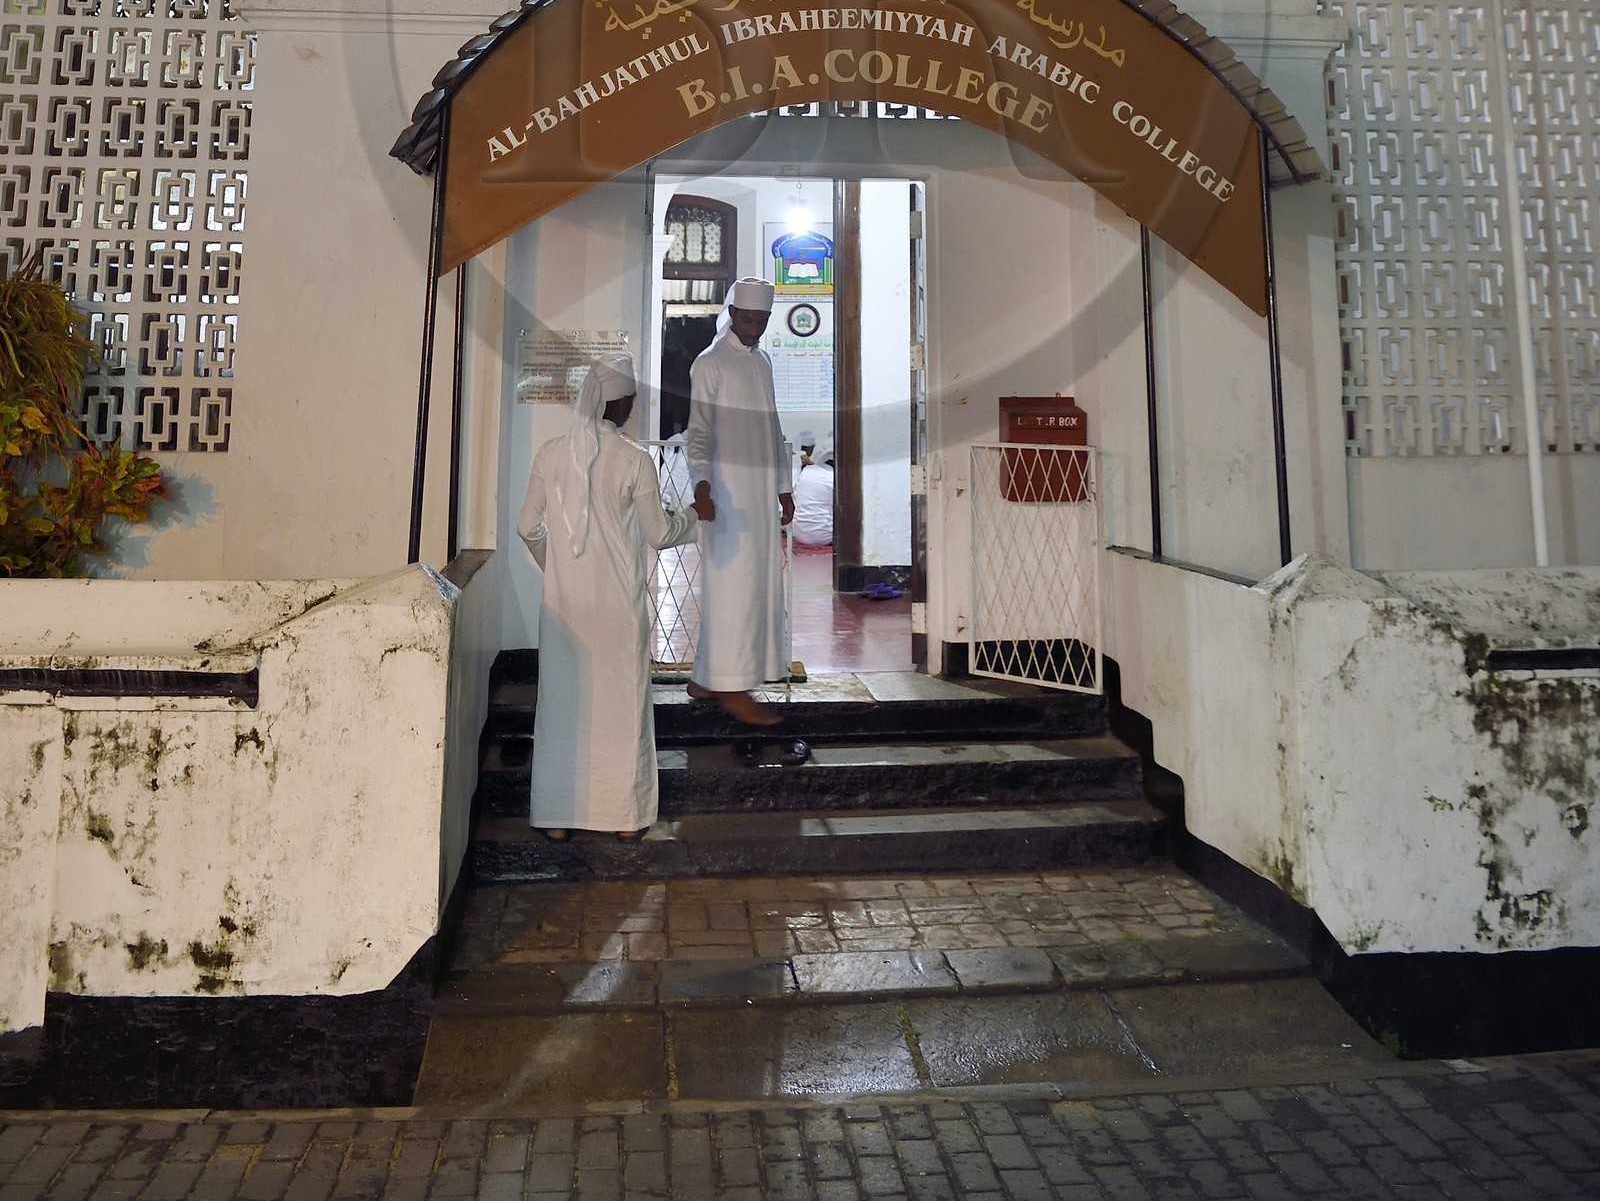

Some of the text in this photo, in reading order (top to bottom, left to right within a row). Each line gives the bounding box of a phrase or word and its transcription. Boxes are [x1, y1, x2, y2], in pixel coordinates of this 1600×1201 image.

[486, 8, 1235, 202] AL-BAHJATHUL IBRAHEEMIYYAH ARABIC COLLEGE
[1017, 416, 1078, 427] LTR BOX
